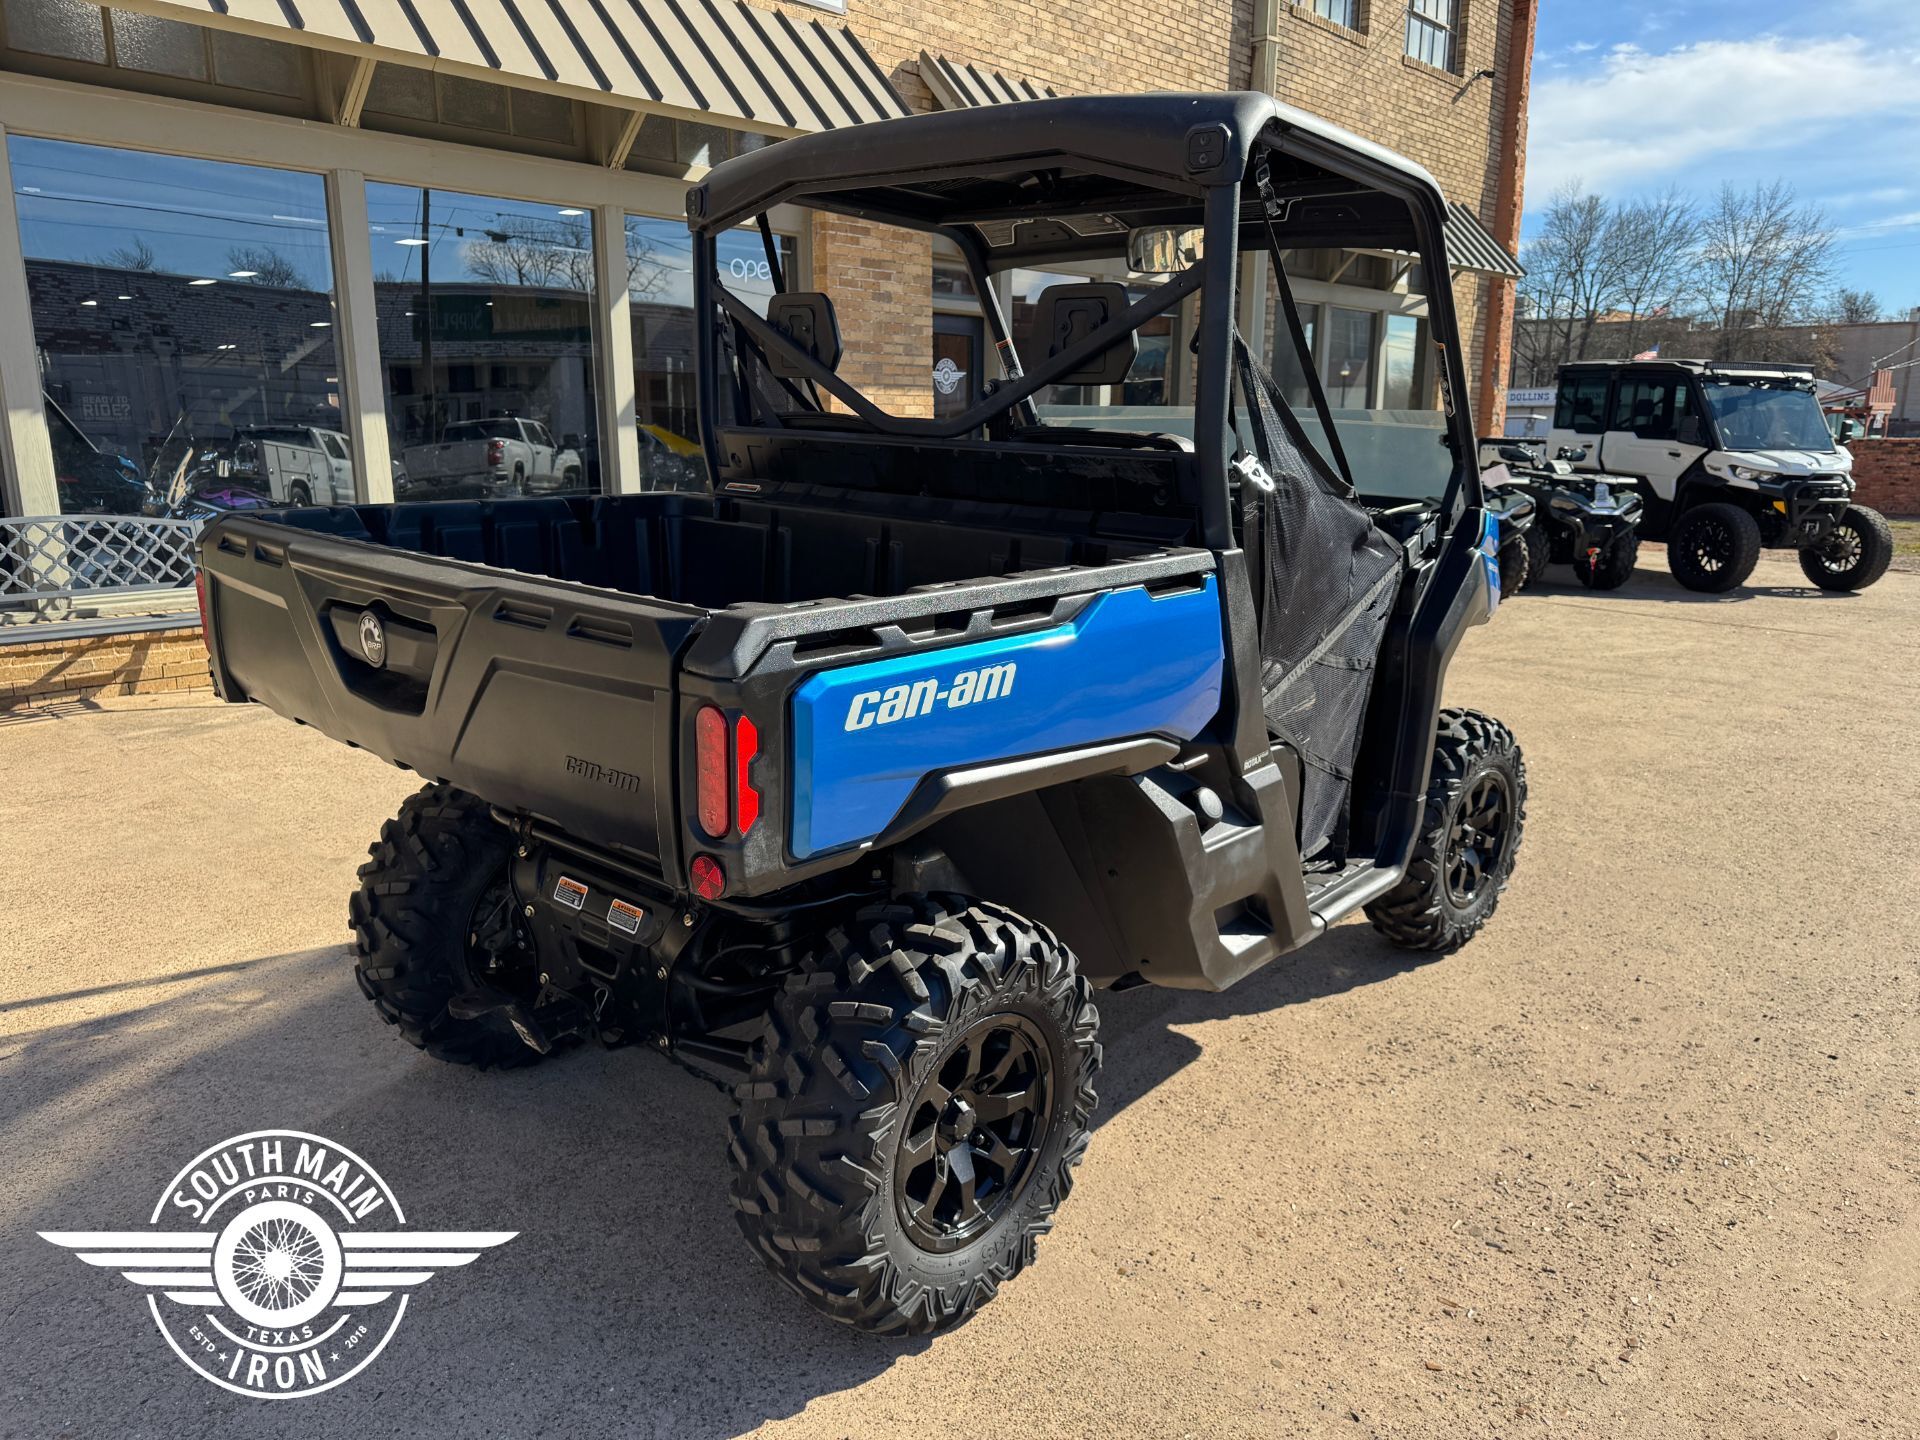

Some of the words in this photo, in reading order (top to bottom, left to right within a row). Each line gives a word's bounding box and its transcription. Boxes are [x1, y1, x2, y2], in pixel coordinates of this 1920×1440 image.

[730, 257, 772, 283] ope
[82, 395, 113, 404] READY
[117, 395, 129, 404] TO
[1509, 391, 1550, 402] DOLLINS
[83, 403, 131, 417] RIDE?
[367, 640, 381, 650] BRP
[844, 662, 1017, 732] can-am
[564, 754, 641, 793] can-am
